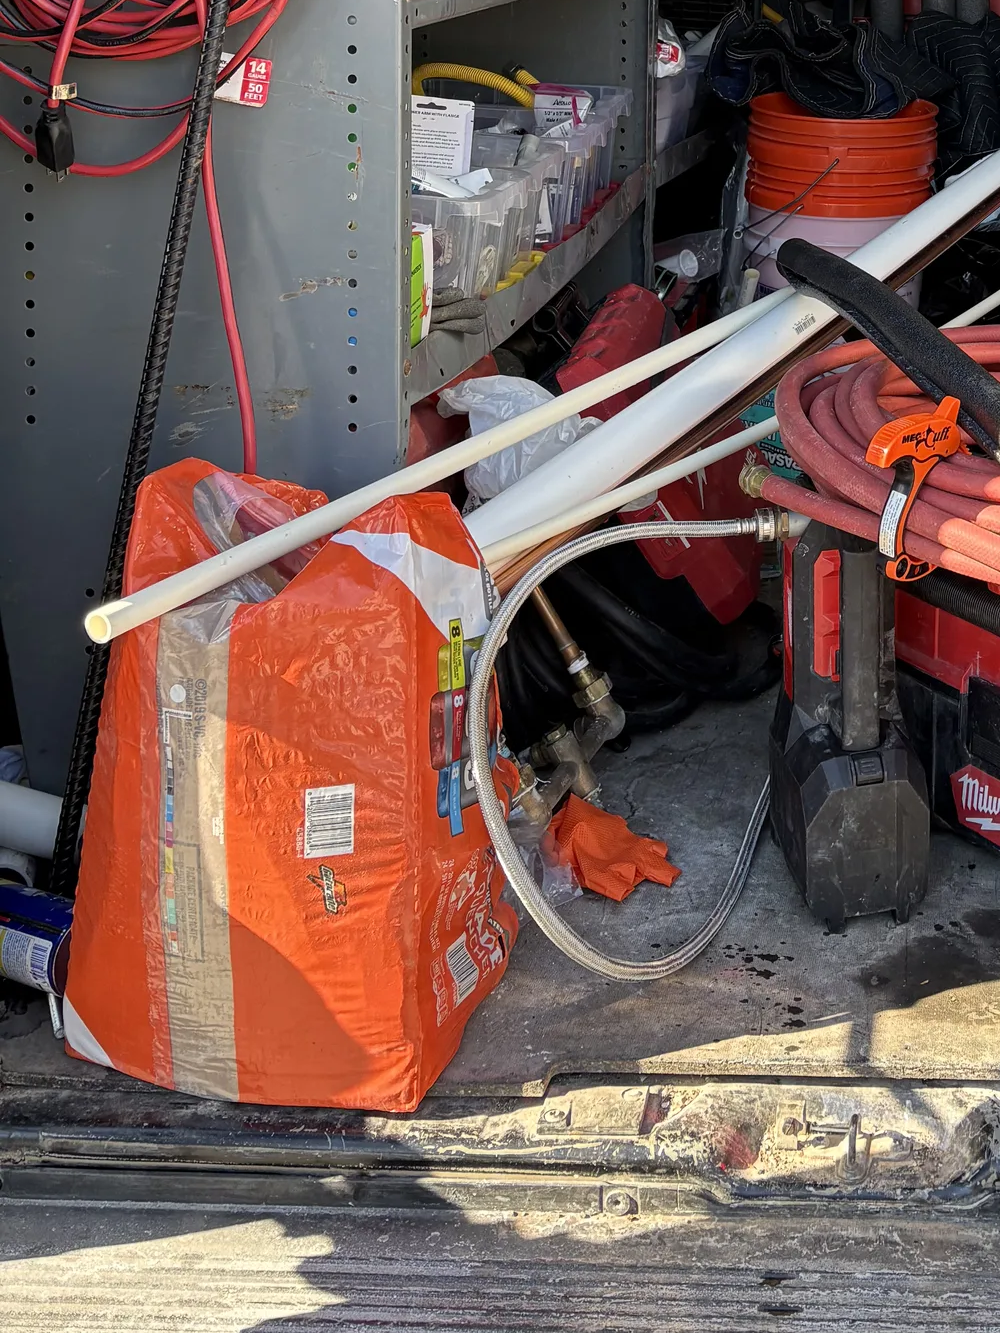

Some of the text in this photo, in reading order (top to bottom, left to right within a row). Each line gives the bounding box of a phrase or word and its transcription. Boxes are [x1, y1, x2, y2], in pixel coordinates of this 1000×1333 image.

[249, 60, 267, 74] 14
[248, 82, 263, 93] 50
[244, 92, 263, 100] FEET
[451, 625, 461, 638] 8
[453, 694, 463, 708] 8
[451, 766, 460, 780] 8
